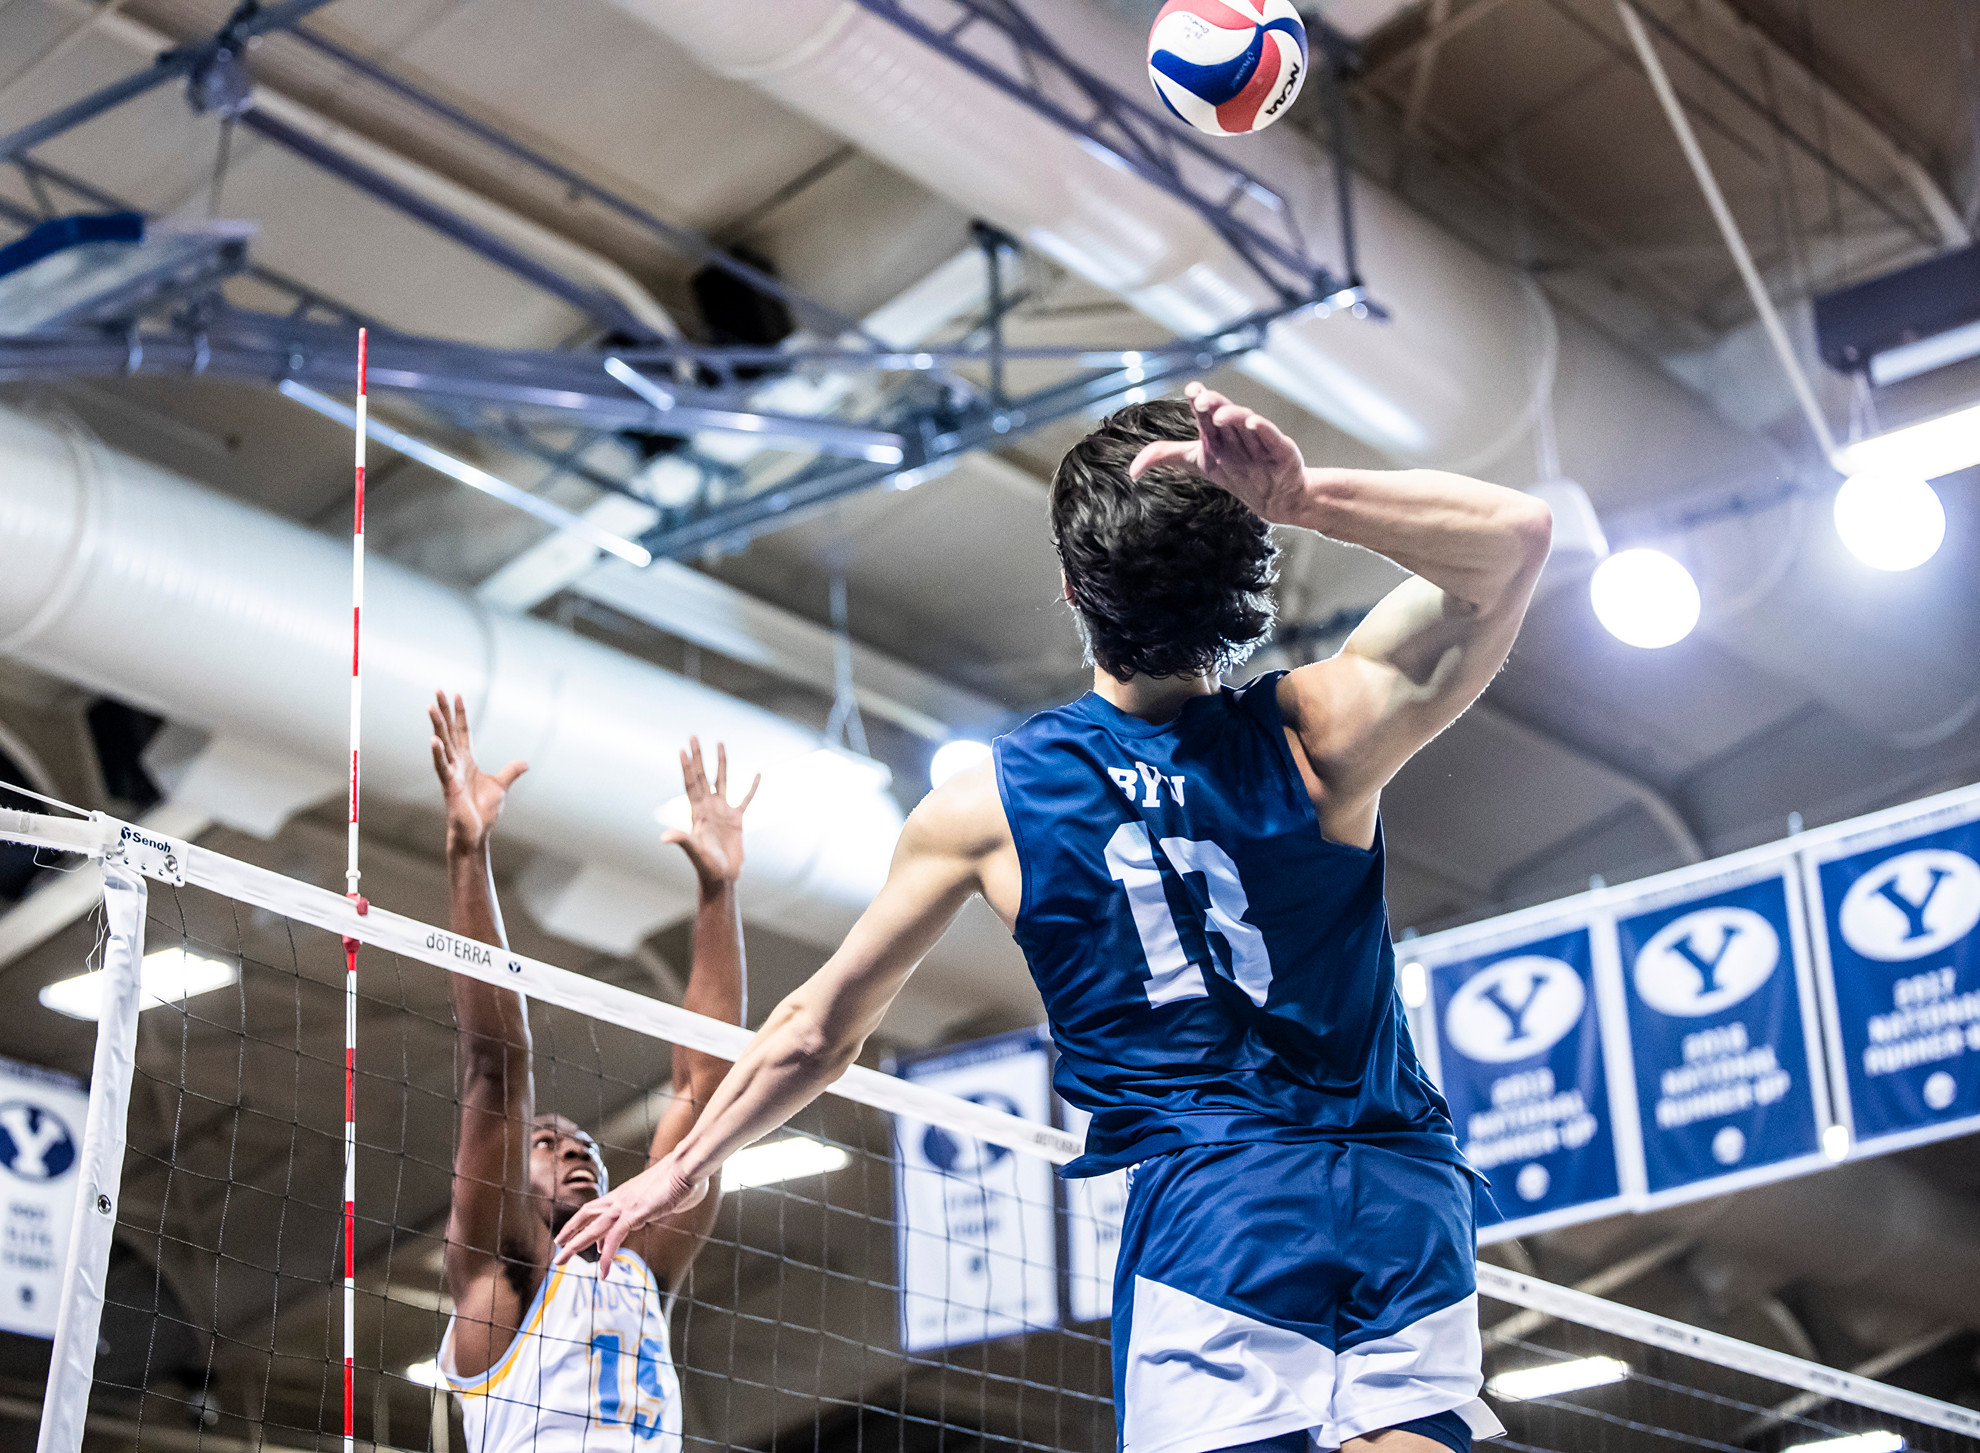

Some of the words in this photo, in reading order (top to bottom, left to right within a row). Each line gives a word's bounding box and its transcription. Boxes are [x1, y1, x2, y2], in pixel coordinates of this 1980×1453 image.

[1265, 62, 1300, 115] NCAA
[1107, 761, 1185, 808] BYU
[132, 831, 171, 853] Senoh
[1103, 820, 1274, 1009] 13
[1867, 867, 1953, 942] Y
[1663, 925, 1742, 999] Y
[1476, 973, 1549, 1043] Y
